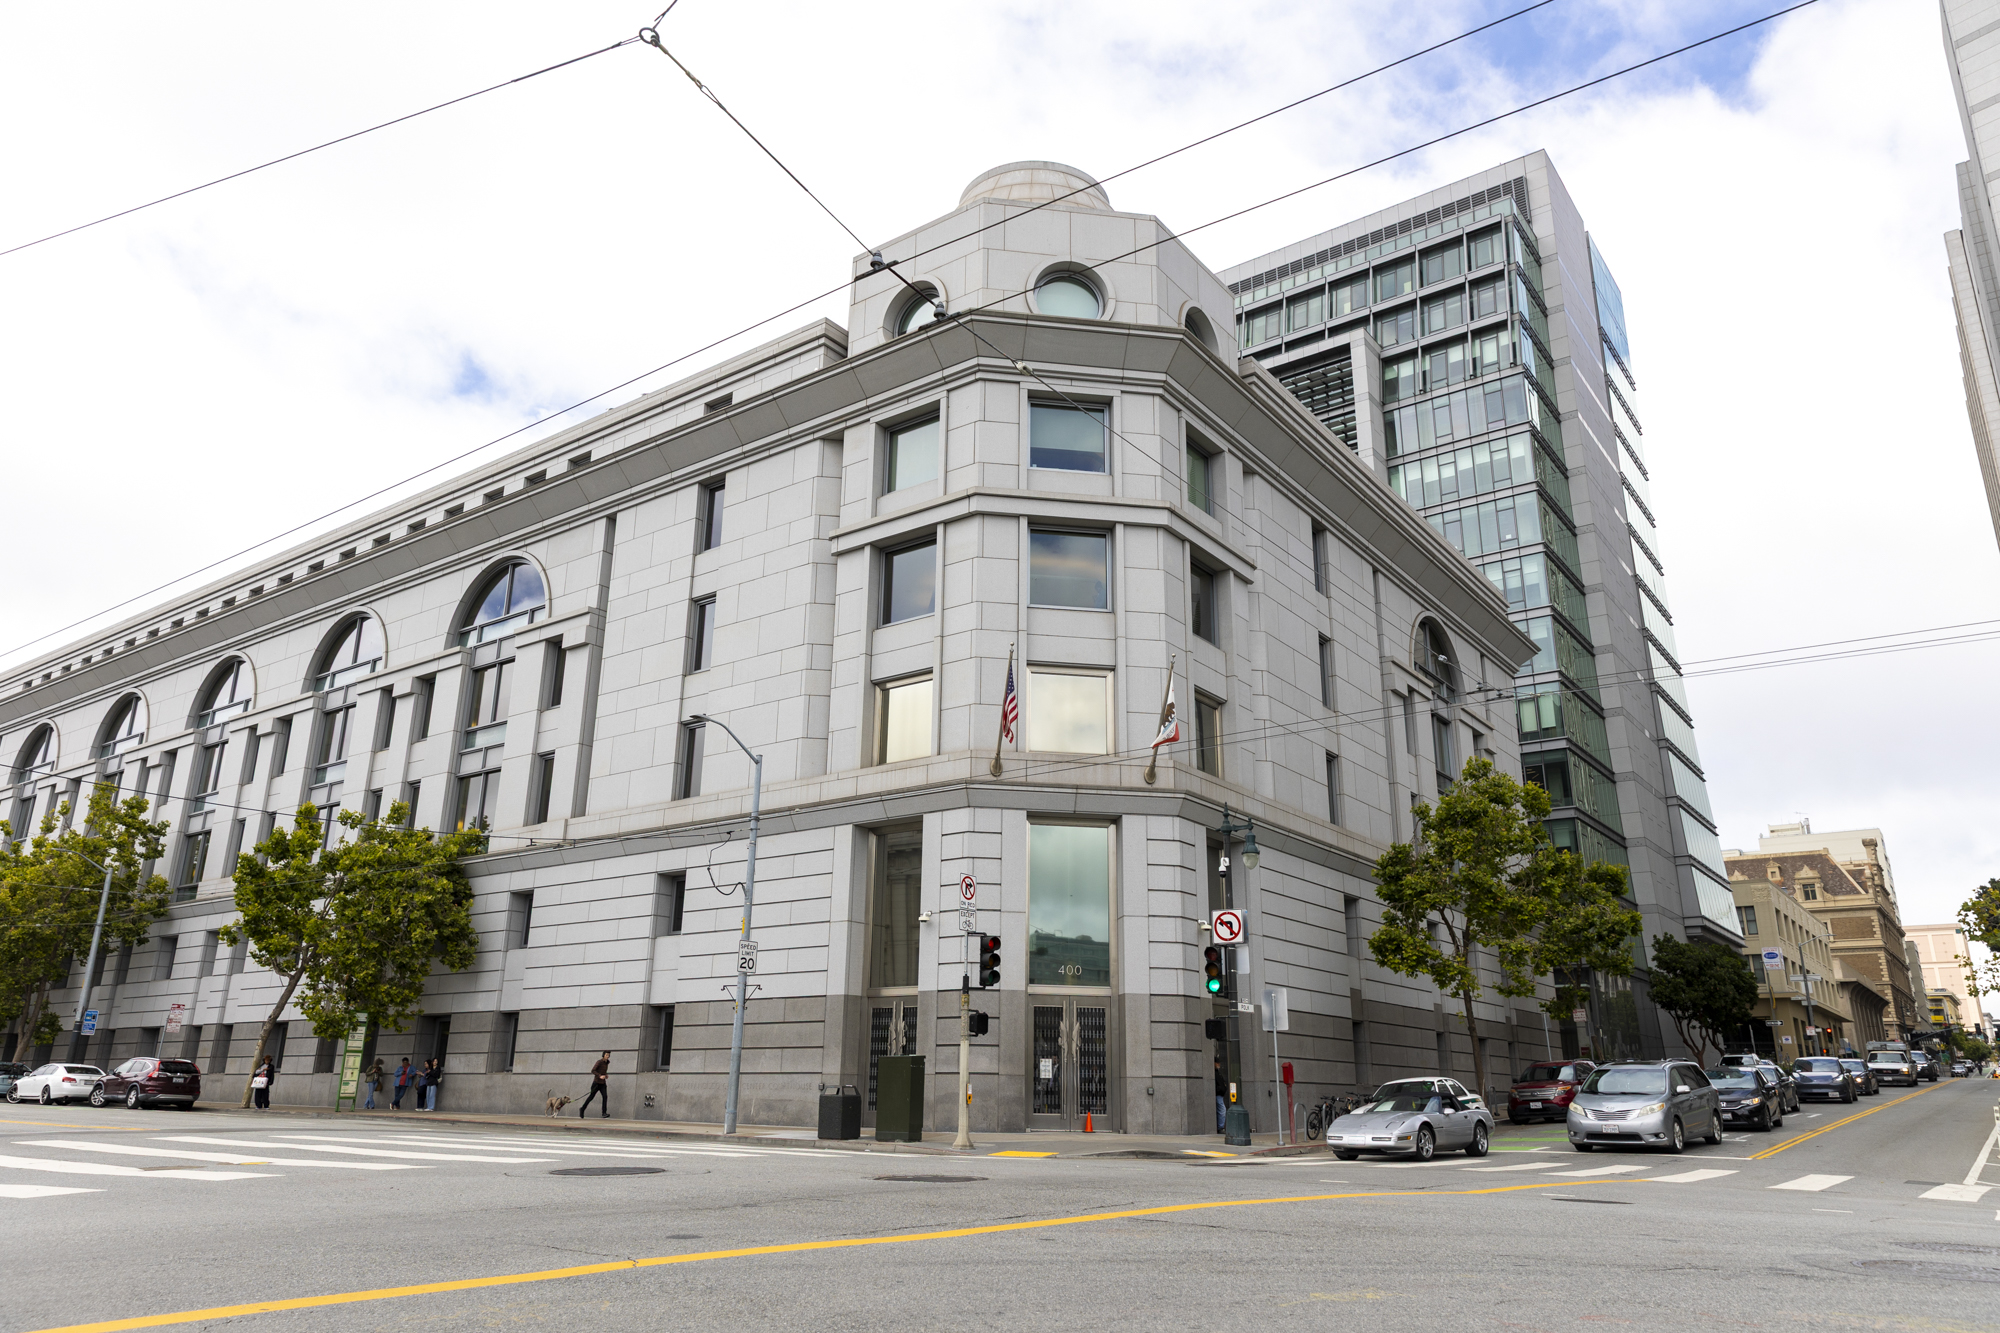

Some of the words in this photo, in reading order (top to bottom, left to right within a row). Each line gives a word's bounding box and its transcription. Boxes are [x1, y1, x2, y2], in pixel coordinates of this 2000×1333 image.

[740, 943, 757, 951] SPEED
[740, 957, 755, 970] 20
[1058, 965, 1082, 975] 400
